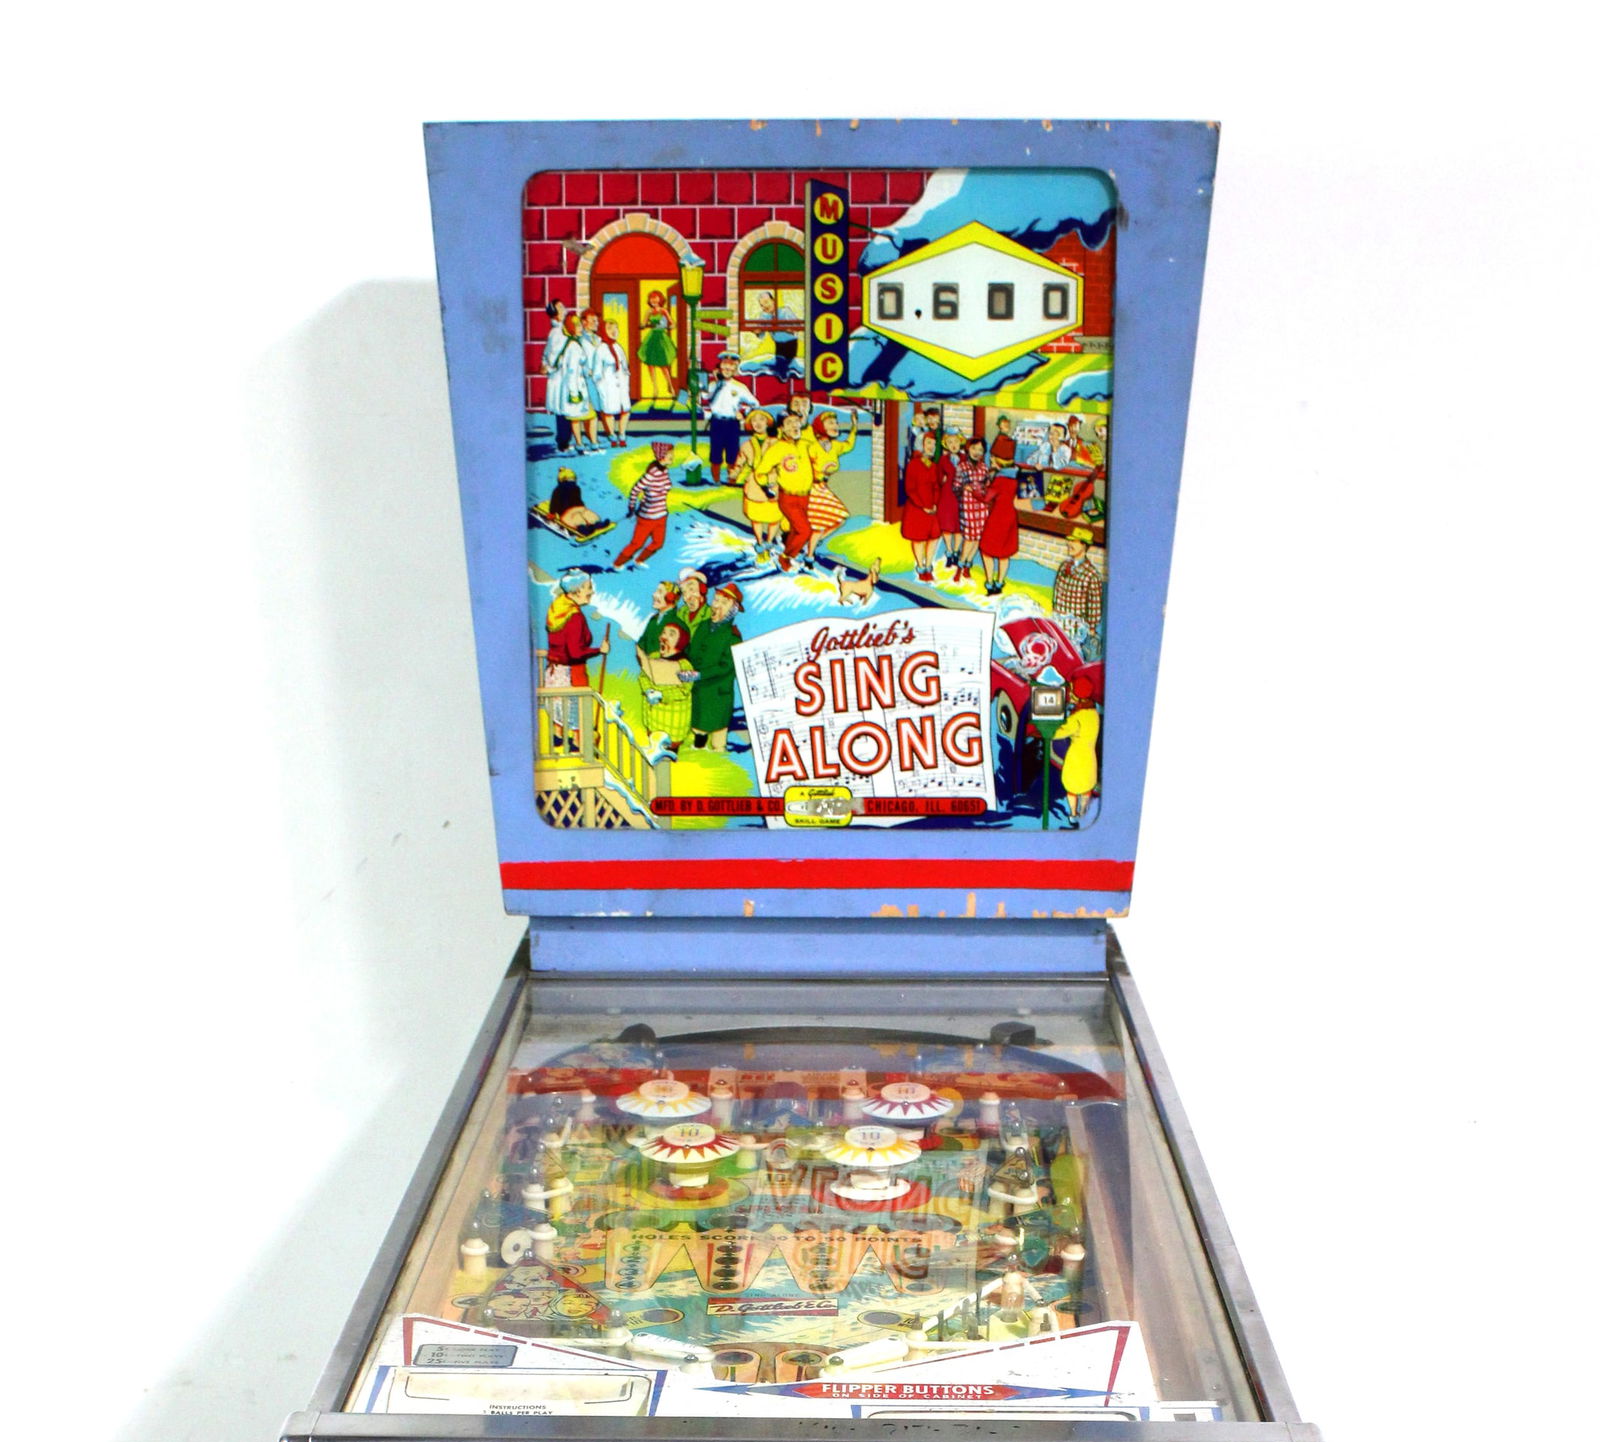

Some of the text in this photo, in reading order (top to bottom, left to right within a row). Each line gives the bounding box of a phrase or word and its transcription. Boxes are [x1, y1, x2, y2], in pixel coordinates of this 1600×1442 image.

[818, 195, 841, 379] MUSIC
[810, 620, 916, 659] Gottlieb's
[794, 651, 942, 716] SING
[1043, 695, 1054, 705] 14
[765, 711, 983, 784] ALONG
[680, 800, 693, 812] BY
[707, 800, 752, 812] GOTTLIEB
[951, 800, 981, 812] 60651
[737, 1301, 802, 1312] Gottlieb
[822, 1384, 995, 1395] FLIPPER BUTTONS
